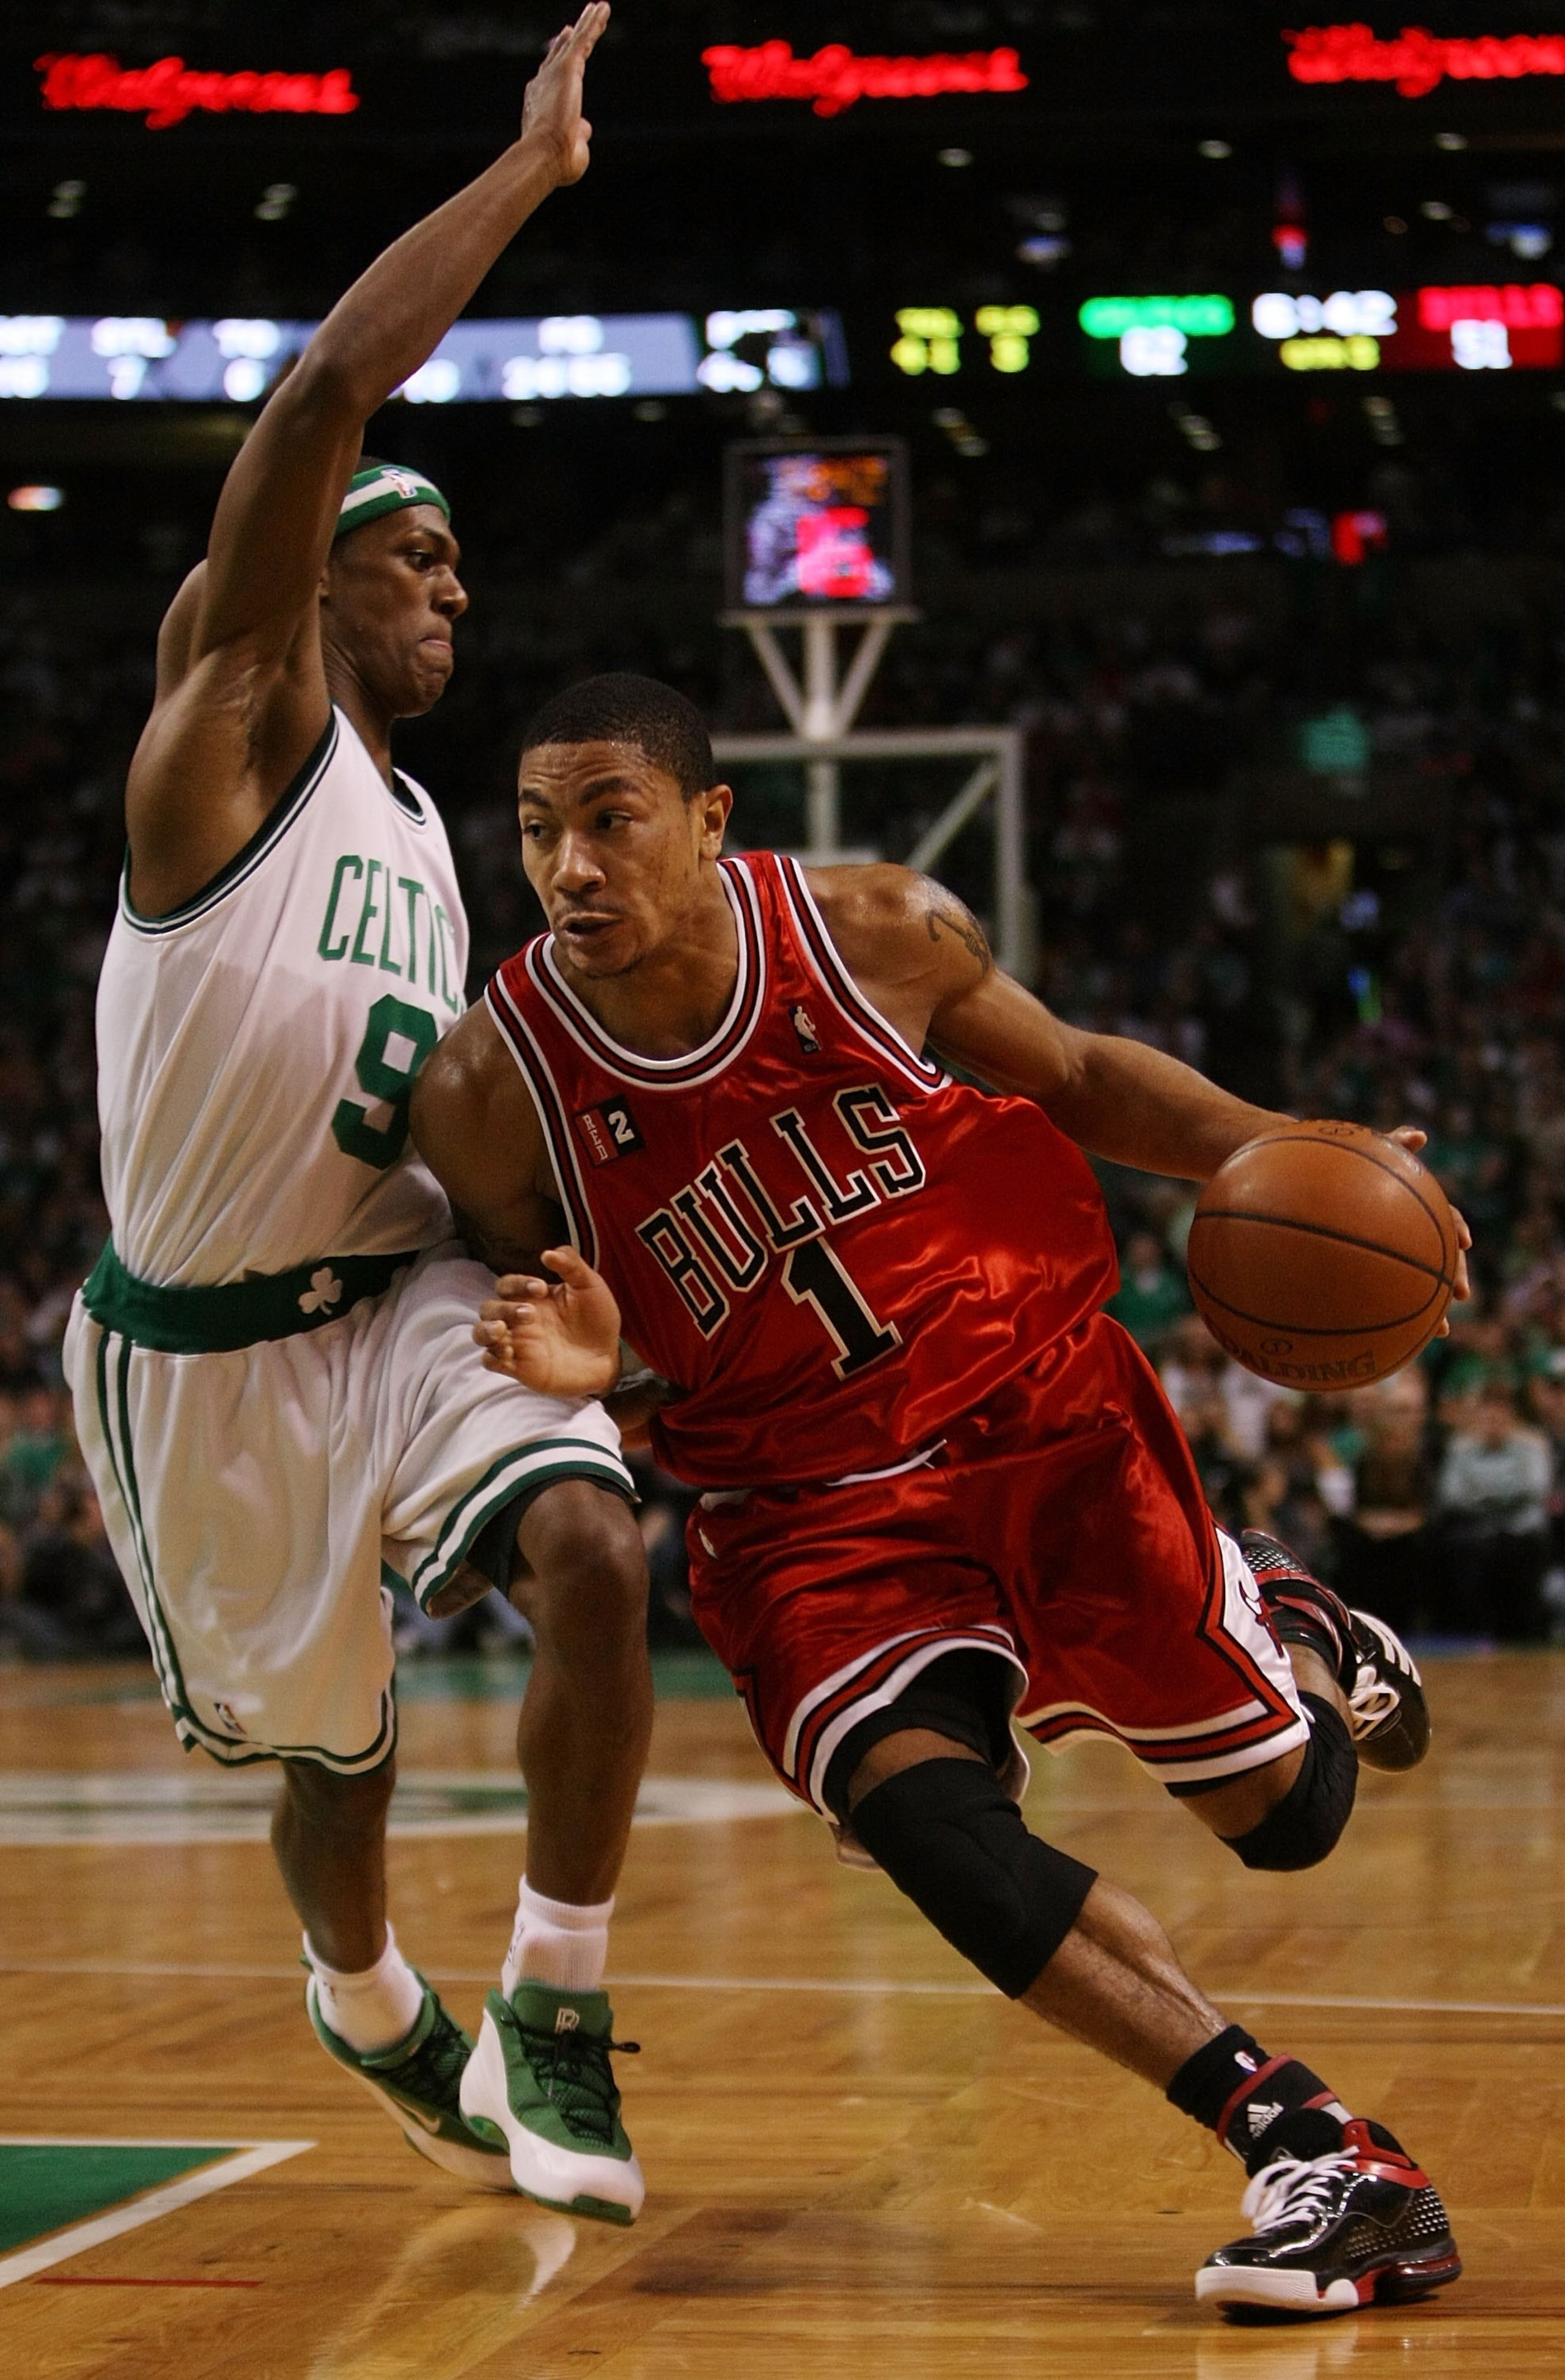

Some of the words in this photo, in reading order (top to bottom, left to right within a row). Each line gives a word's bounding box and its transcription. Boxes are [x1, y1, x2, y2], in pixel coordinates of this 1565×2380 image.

[317, 855, 463, 1015] CELTIC
[331, 993, 438, 1170] 9
[582, 1114, 609, 1161] RED
[608, 1110, 635, 1144] 2
[635, 1083, 926, 1341] BULLS
[781, 1237, 903, 1382] 1
